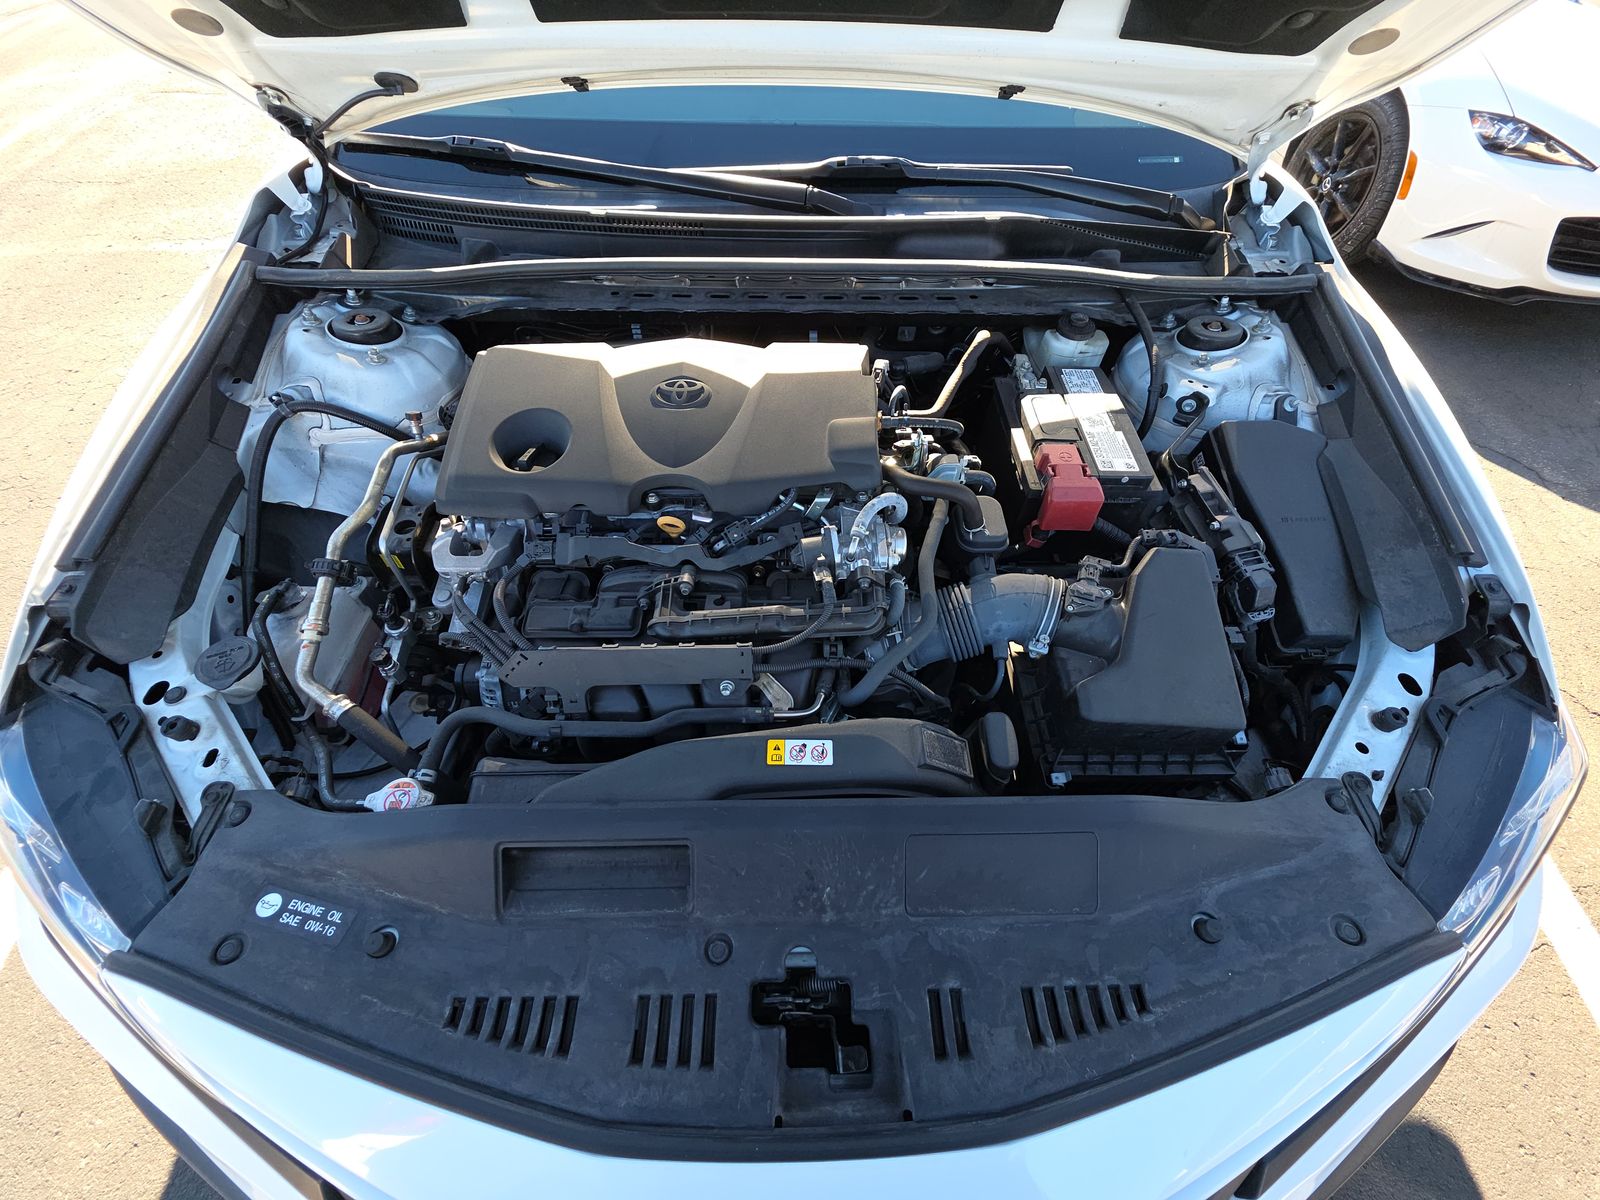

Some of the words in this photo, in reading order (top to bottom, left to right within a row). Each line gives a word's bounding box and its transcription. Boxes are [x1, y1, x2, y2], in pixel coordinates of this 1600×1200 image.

[287, 898, 325, 917] ENGINE
[327, 910, 343, 923] OIL
[279, 912, 302, 927] SAE
[304, 920, 336, 936] 0W-16
